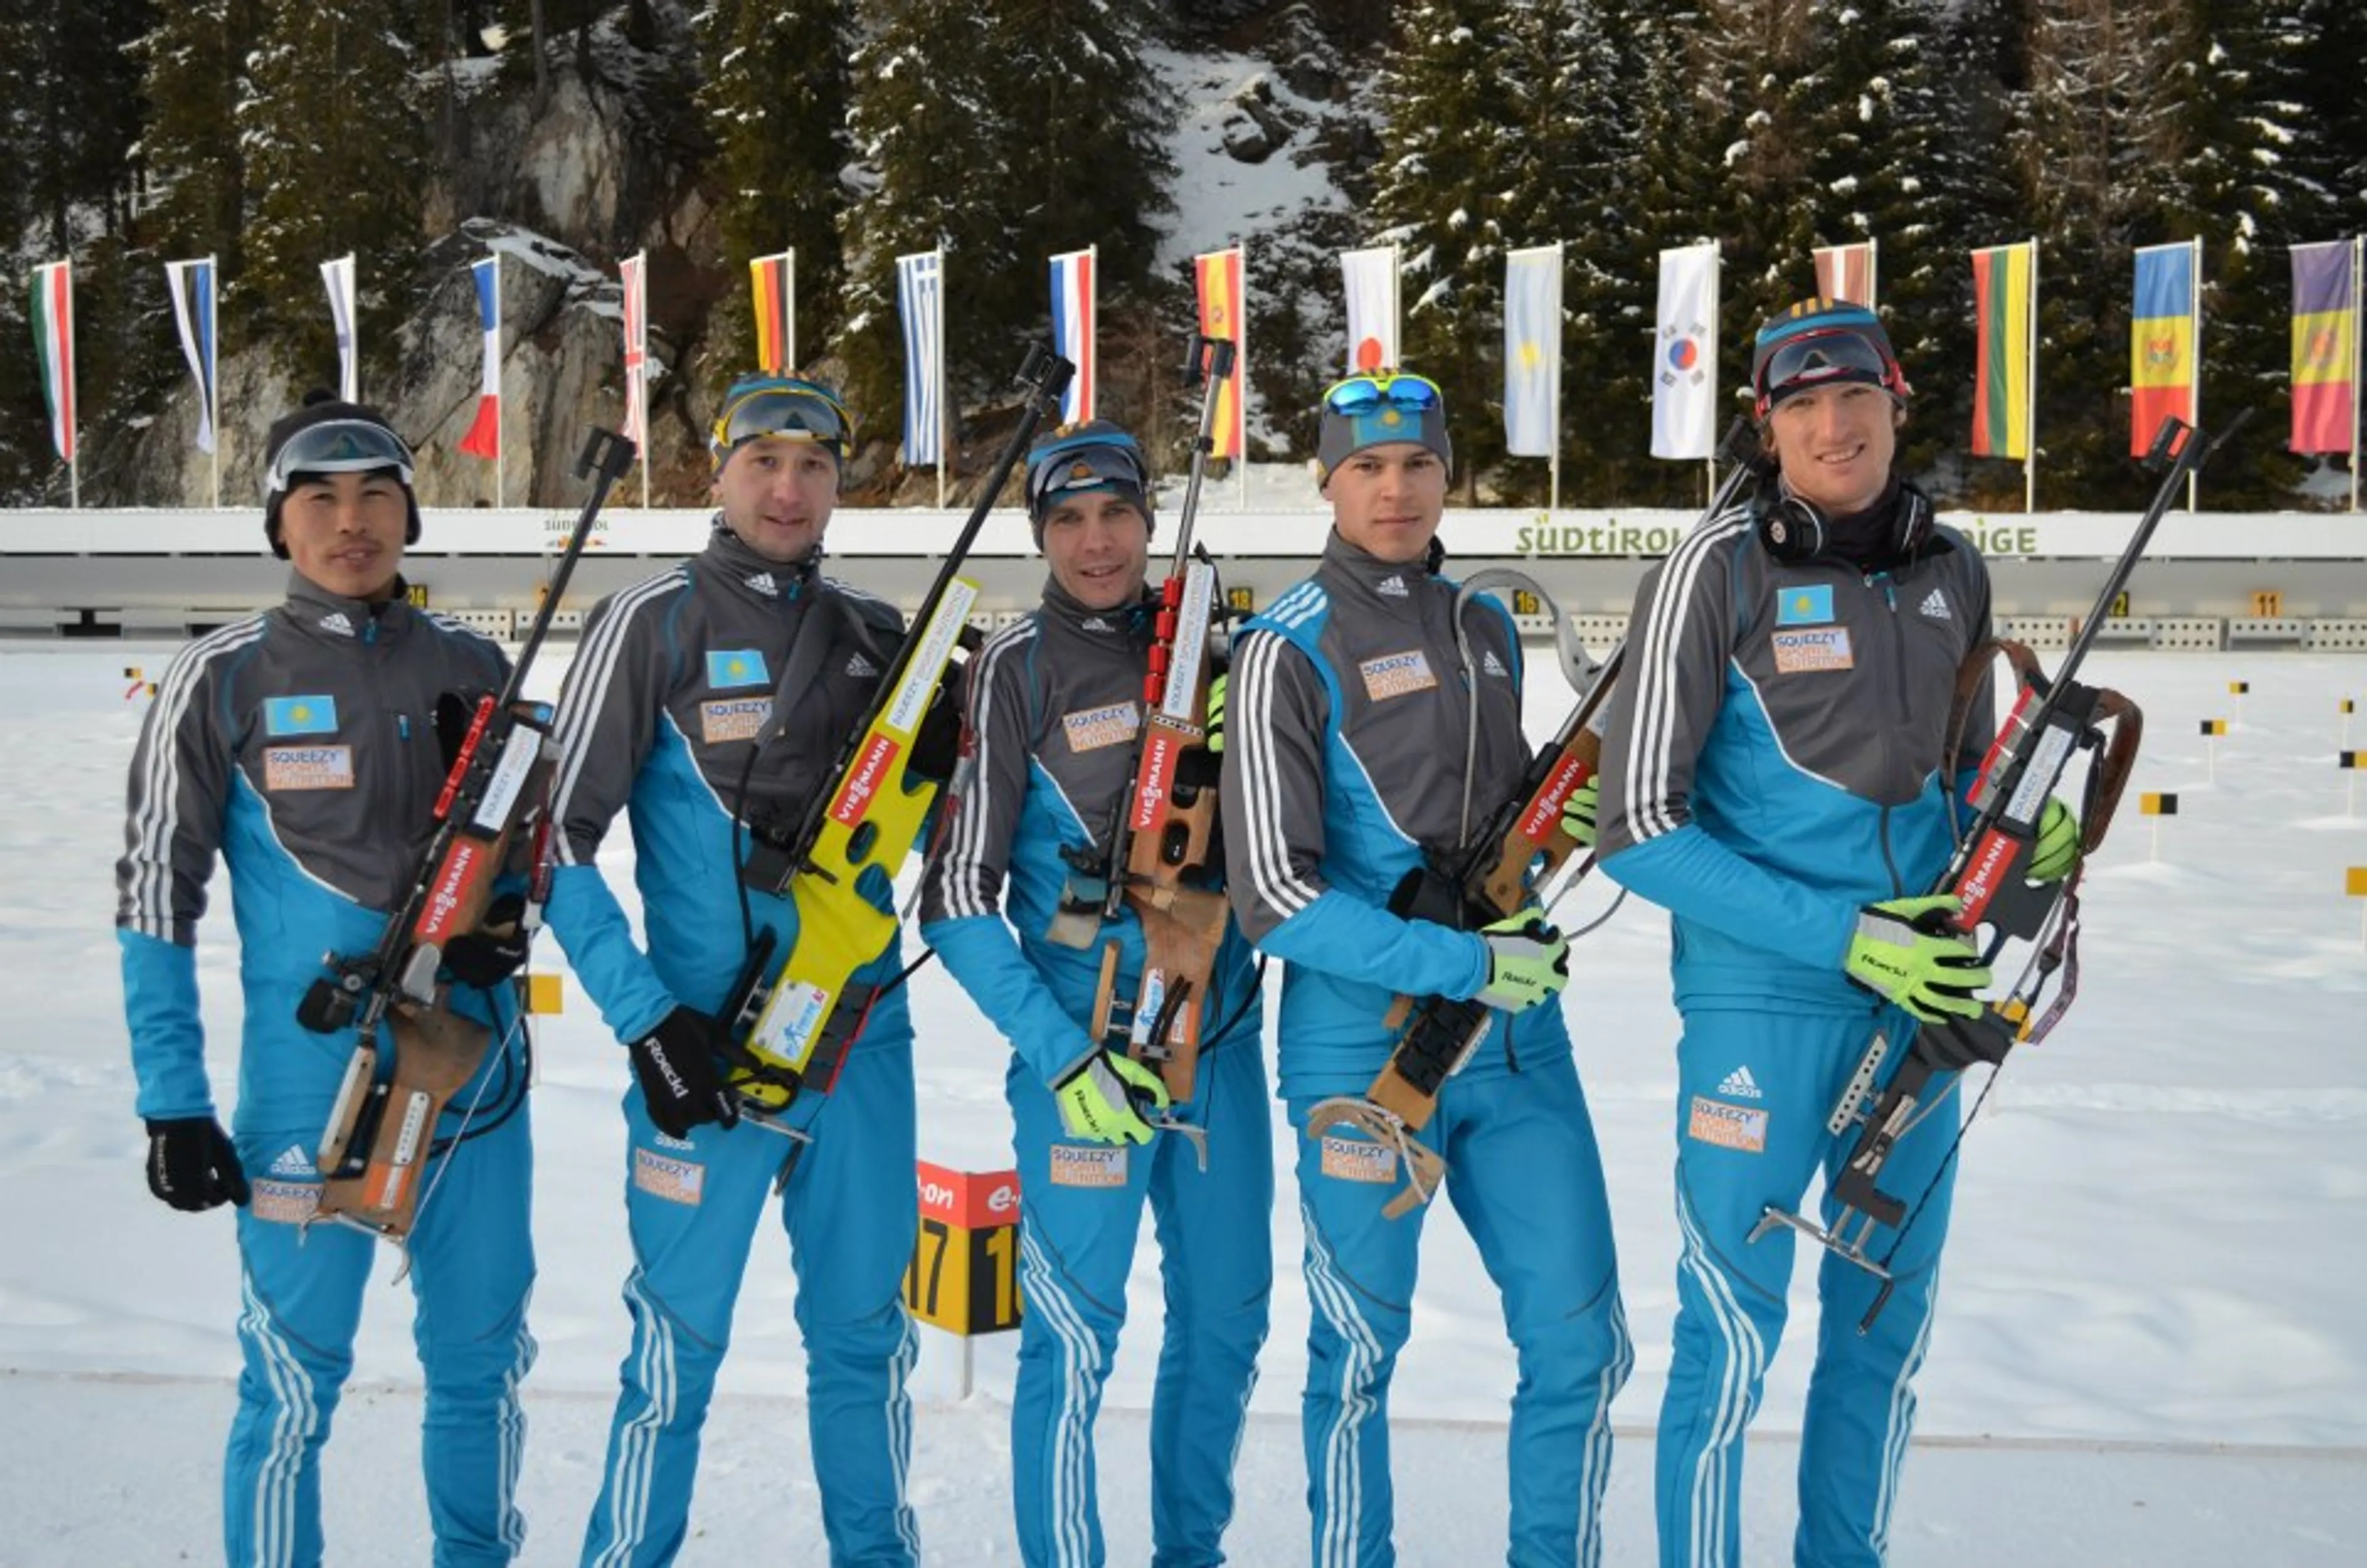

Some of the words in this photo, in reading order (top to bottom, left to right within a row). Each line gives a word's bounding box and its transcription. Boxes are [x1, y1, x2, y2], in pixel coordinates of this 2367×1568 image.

[1231, 589, 1251, 611] 18
[1517, 590, 1538, 613] 16
[2258, 594, 2276, 617] 11
[1775, 632, 1836, 647] SQUEEZY
[1363, 655, 1419, 675] SQUEEZY
[705, 701, 767, 716] SQUEEZY
[1067, 706, 1125, 729] SQUEEZY
[271, 749, 337, 764] SQUEEZY
[838, 739, 889, 821] VIESSMANN
[1140, 740, 1167, 826] VIESSMANN
[1526, 761, 1580, 835] VIESSMANN
[426, 846, 473, 933] VIESSMANN
[1954, 837, 2008, 921] VIESSMANN
[645, 1036, 689, 1100] Roeckl
[1717, 1084, 1762, 1098] adidas
[1694, 1100, 1752, 1124] SQUEEZY
[1052, 1148, 1116, 1163] SQUEEZY
[1322, 1139, 1384, 1159] SQUEEZY
